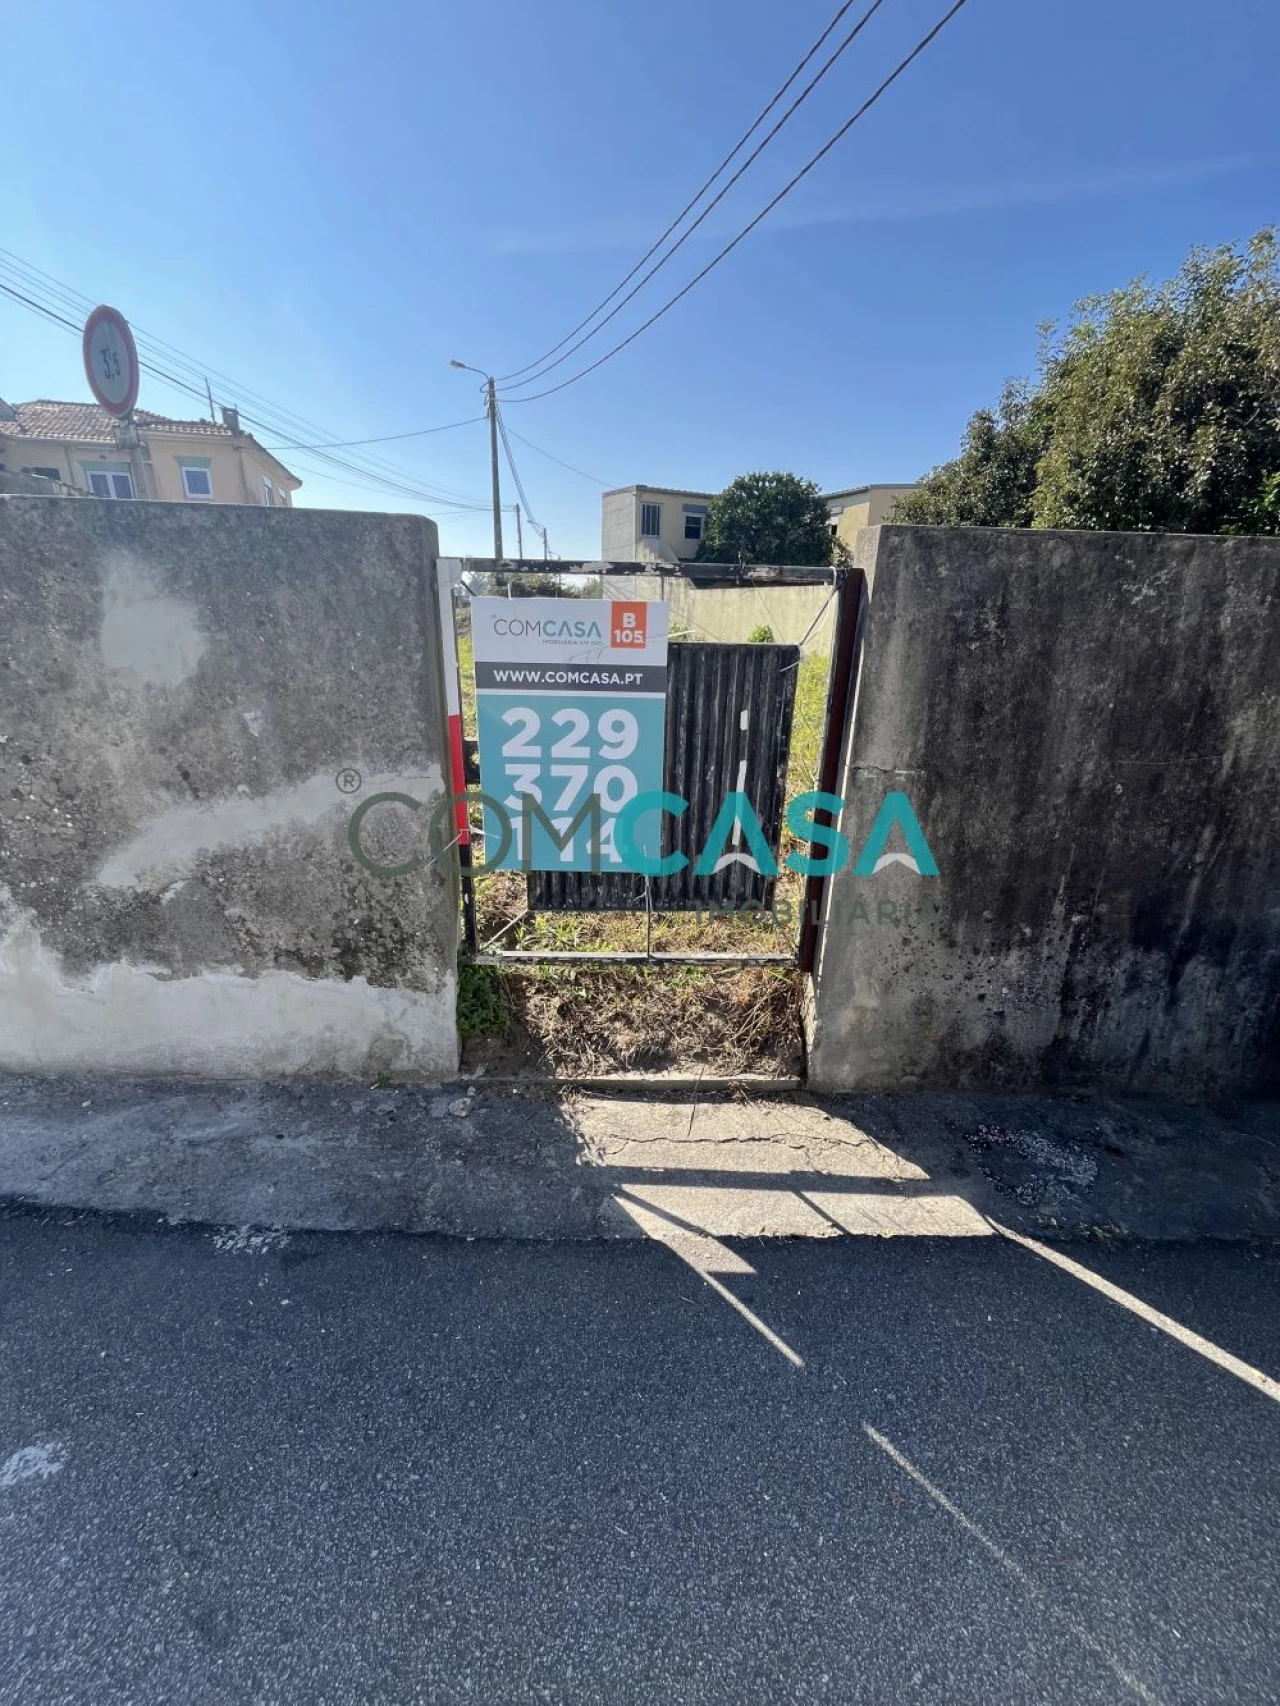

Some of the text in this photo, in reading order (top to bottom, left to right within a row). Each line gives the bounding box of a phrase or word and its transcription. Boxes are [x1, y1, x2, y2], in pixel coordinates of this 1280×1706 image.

[493, 618, 602, 638] COMCASA
[622, 612, 636, 628] B
[614, 629, 645, 643] 105
[493, 670, 643, 685] WWW.COMCASA.PT
[501, 707, 639, 760] 229
[503, 763, 638, 811] 370
